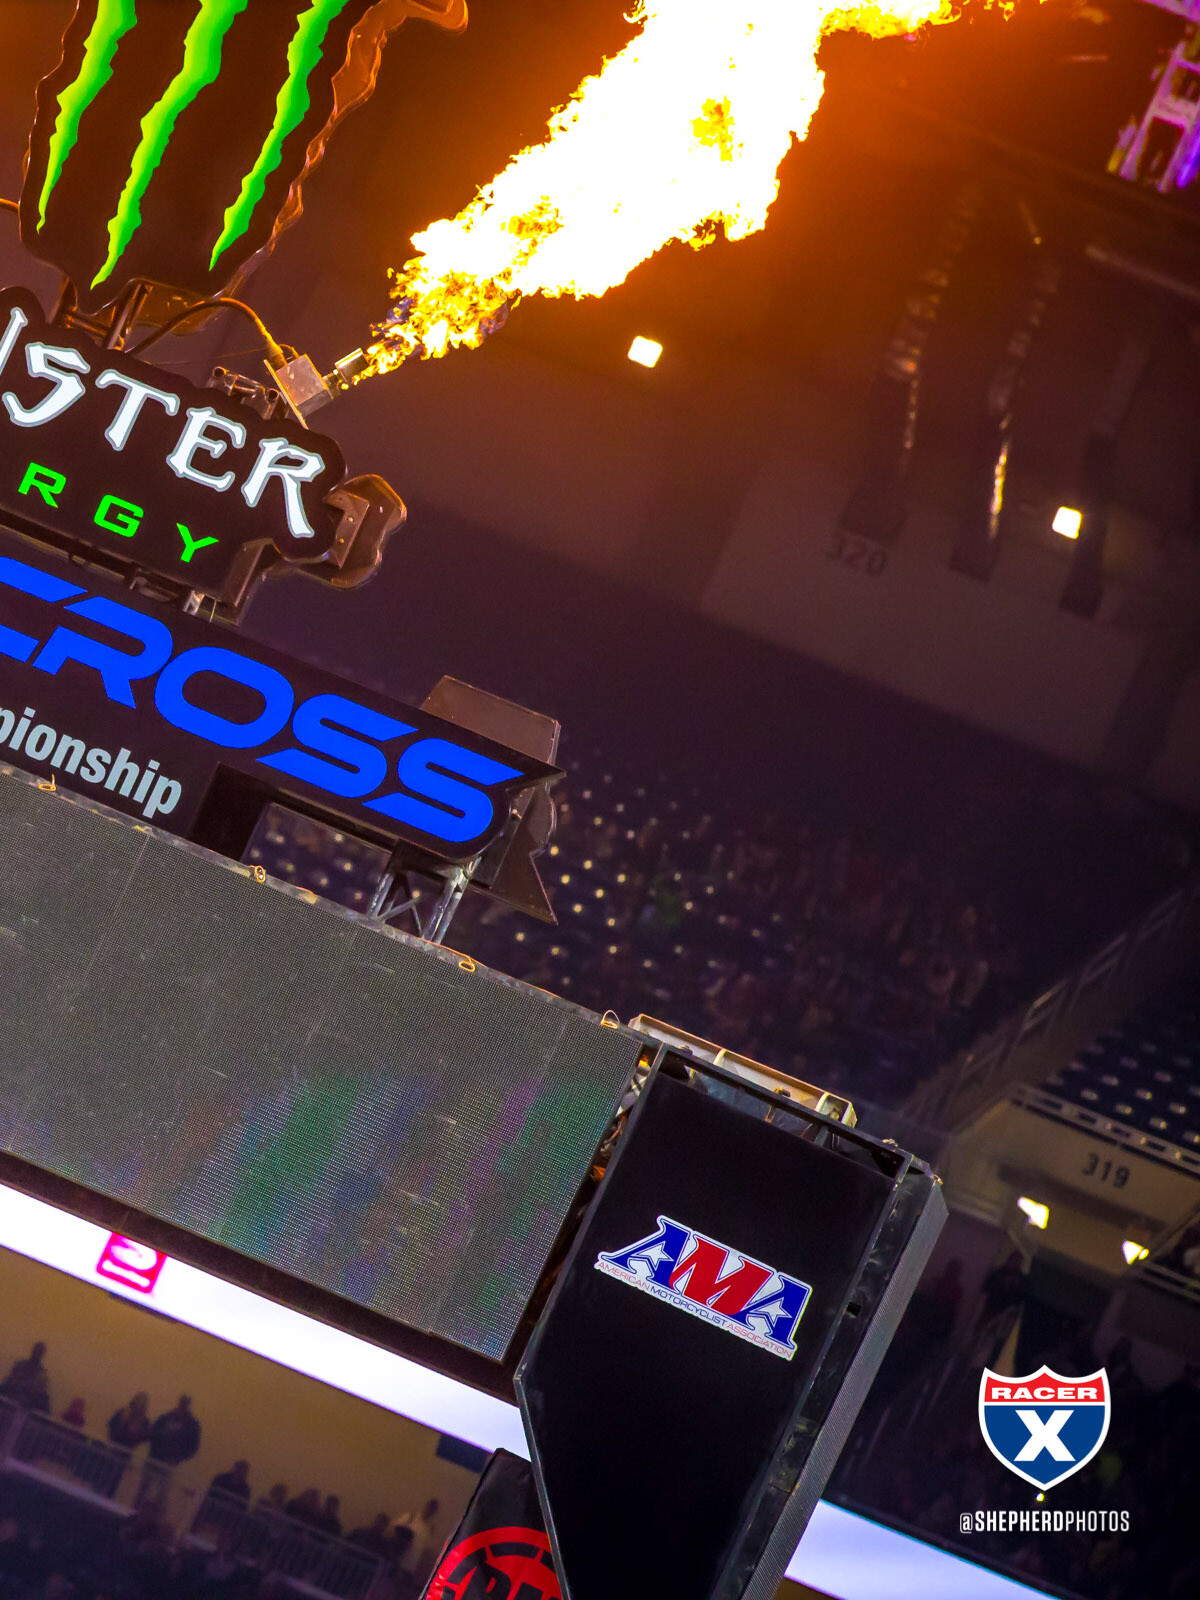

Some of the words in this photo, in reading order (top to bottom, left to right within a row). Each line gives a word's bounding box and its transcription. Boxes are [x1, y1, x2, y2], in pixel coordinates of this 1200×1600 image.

[824, 530, 889, 577] 320
[1081, 1152, 1131, 1188] 319
[597, 1260, 650, 1291] AMERICAN
[649, 1286, 728, 1328] MOTORCYCLIST
[726, 1322, 792, 1358] ASSOCIATION
[601, 1216, 811, 1349] AMA
